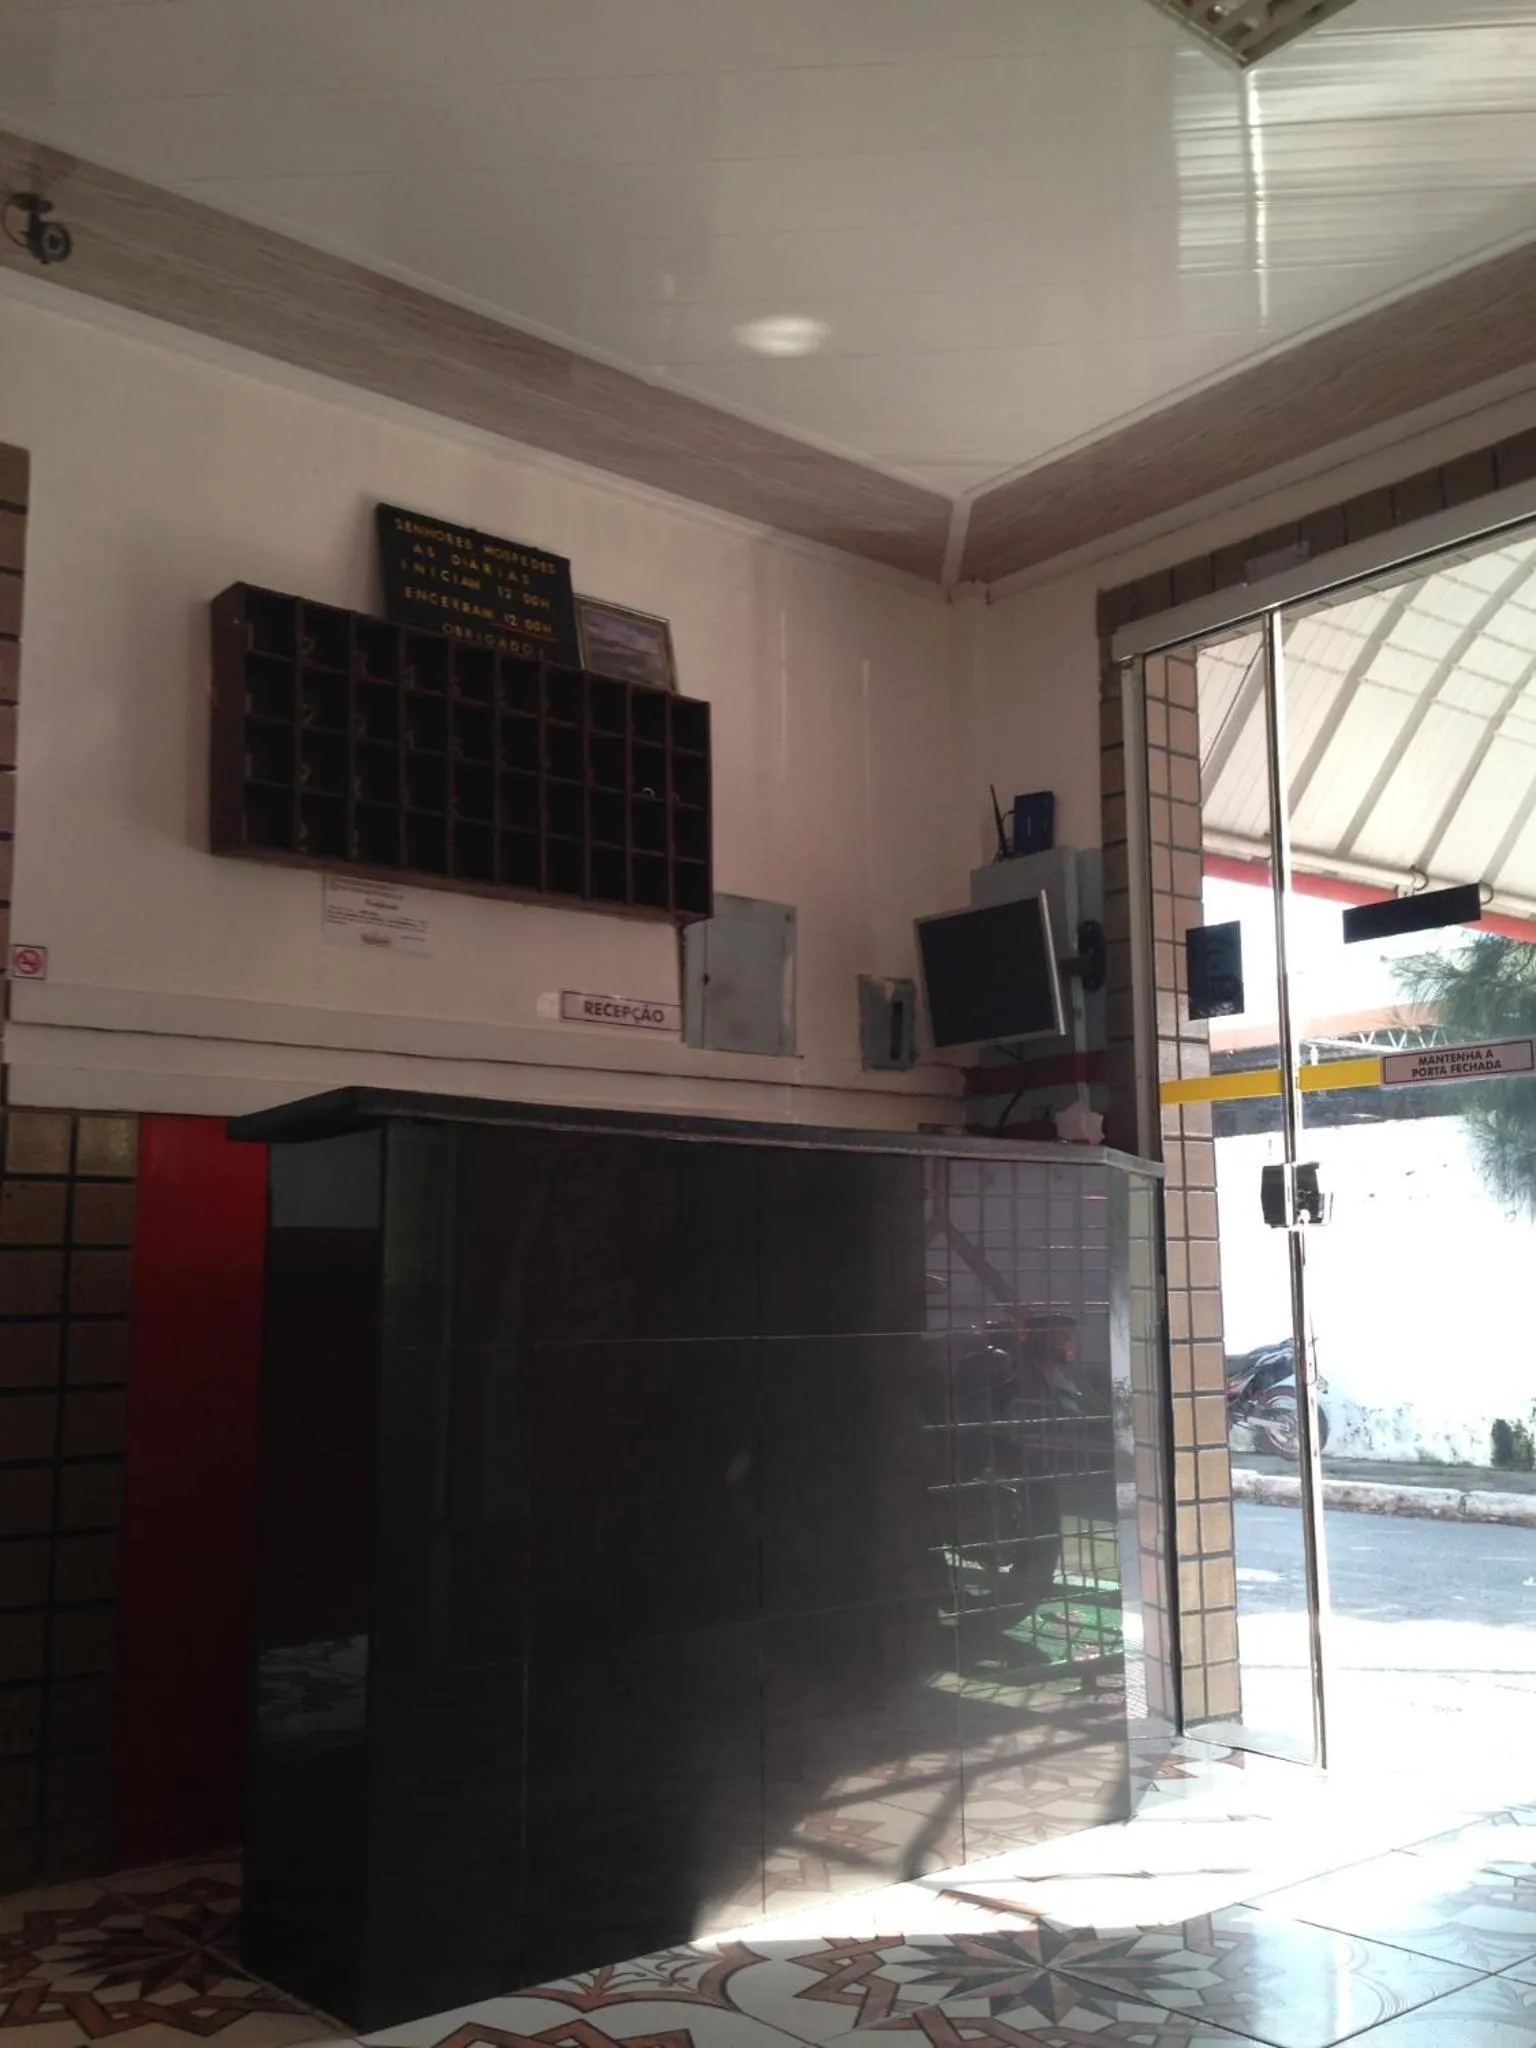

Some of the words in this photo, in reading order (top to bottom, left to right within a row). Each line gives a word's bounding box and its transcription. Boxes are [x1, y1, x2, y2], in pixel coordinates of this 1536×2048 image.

[394, 518, 473, 549] SENHORES
[412, 543, 436, 558] AS
[584, 1003, 664, 1024] RECEPÇÃO
[1418, 1051, 1482, 1065] MANTENHA
[1485, 1050, 1493, 1059] A
[1411, 1066, 1447, 1077] PORTA
[1450, 1059, 1502, 1073] FECHADA
